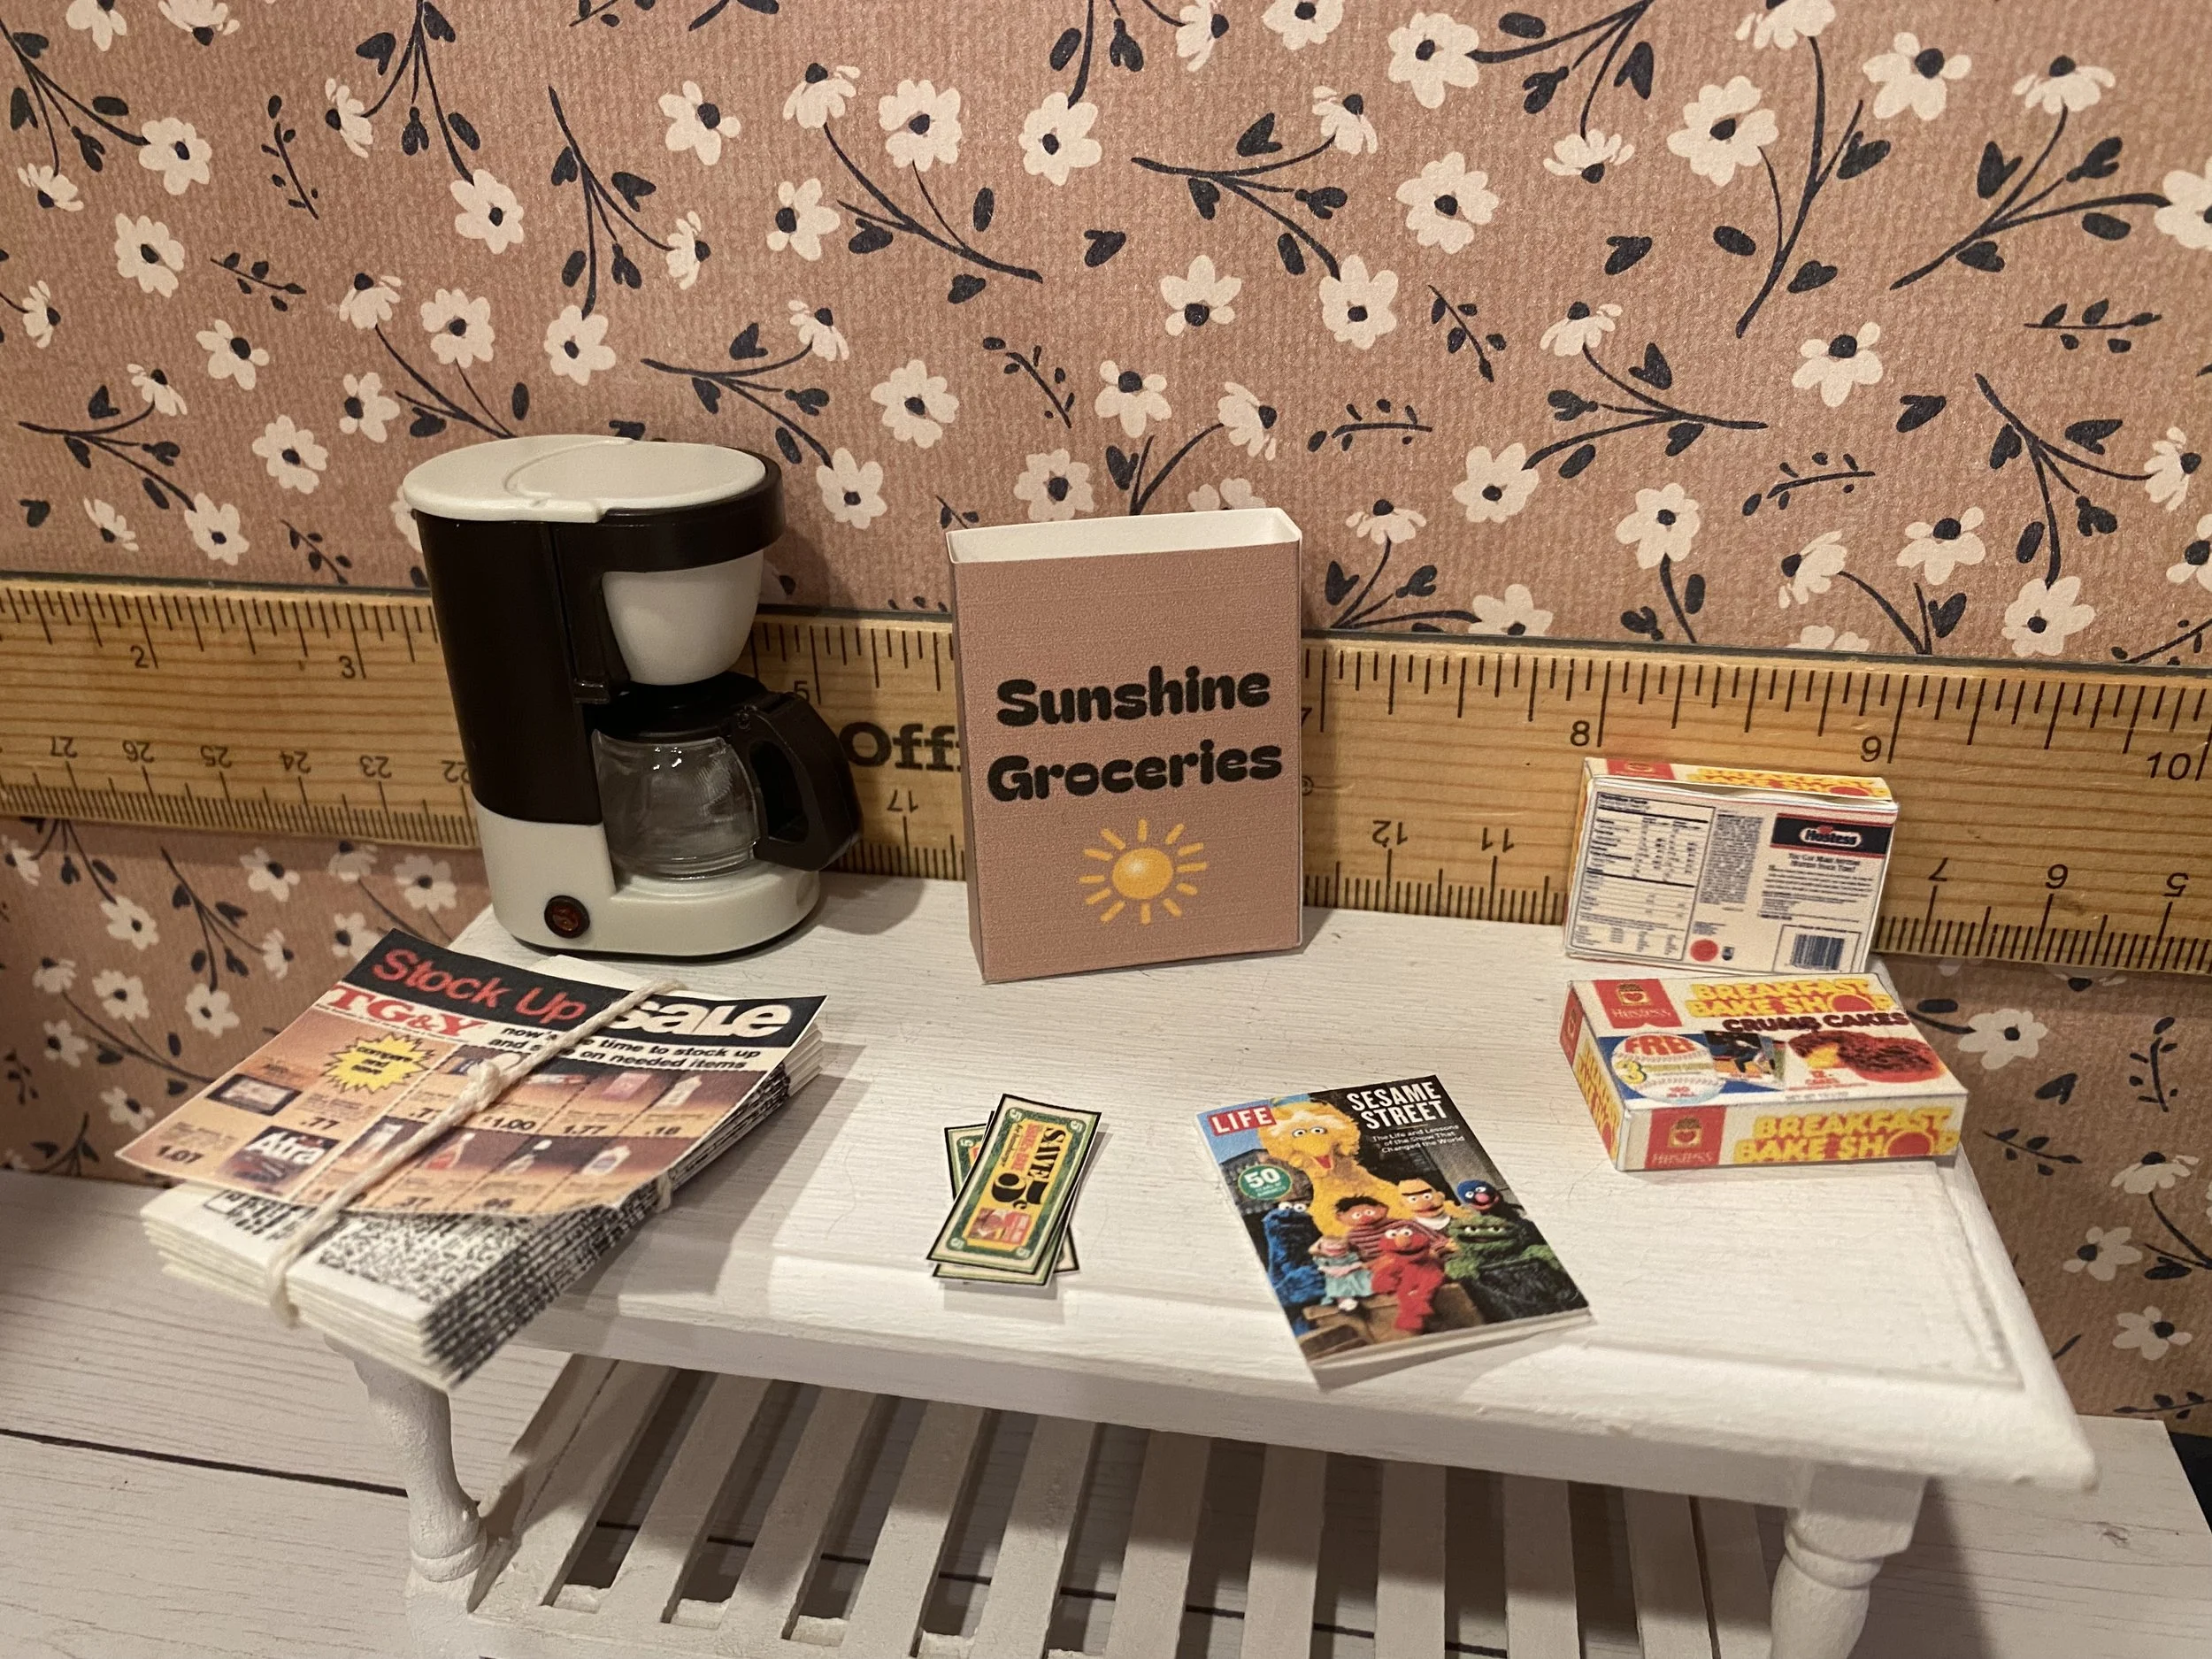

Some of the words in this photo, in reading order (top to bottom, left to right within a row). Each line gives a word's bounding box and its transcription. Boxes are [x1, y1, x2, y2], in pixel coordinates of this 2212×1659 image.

[130, 645, 150, 669] 2
[339, 656, 356, 679] 3
[996, 665, 1271, 727] Sunshine
[50, 735, 78, 757] 27
[839, 721, 961, 772] Off
[1570, 721, 1590, 747] 8
[122, 741, 154, 763] 26
[200, 745, 232, 768] 25
[279, 750, 311, 773] 24
[1860, 736, 1882, 763] 9
[359, 756, 392, 779] 23
[987, 739, 1282, 802] Groceries
[2147, 751, 2192, 780] 10
[1371, 820, 1408, 847] 12
[1482, 827, 1514, 852] 11
[1928, 857, 1948, 881] 7
[2164, 872, 2189, 897] 5
[373, 949, 512, 1009] Stock
[515, 987, 587, 1024] Up
[1691, 979, 1869, 1000] BREAKFAST
[328, 984, 488, 1036] TG&Y
[1686, 998, 1777, 1017] BAKE
[1722, 1017, 1822, 1033] CRUMB
[1823, 1012, 1909, 1027] CAKES
[488, 1039, 528, 1049] and
[580, 1050, 606, 1060] on
[607, 1054, 686, 1069] needed
[688, 1059, 748, 1071] items
[600, 1039, 646, 1054] time
[650, 1045, 670, 1056] to
[672, 1046, 728, 1058] stock
[733, 1048, 762, 1059] up
[1615, 1060, 1647, 1085] 3
[1346, 1081, 1441, 1111] SESAME
[1010, 1109, 1023, 1122] 5
[1070, 1119, 1084, 1133] 5
[1210, 1106, 1272, 1133] LIFE
[1361, 1100, 1447, 1129] STREET
[1753, 1108, 1953, 1139] BREAKFAST
[1425, 1125, 1459, 1133] Lessons
[243, 1131, 324, 1166] Atra
[1027, 1126, 1067, 1179] SAVE
[1381, 1141, 1421, 1154] Changed
[1437, 1135, 1465, 1145] World
[1733, 1136, 1828, 1164] BAKE
[1244, 1167, 1281, 1188] 50
[949, 1237, 965, 1249] 5
